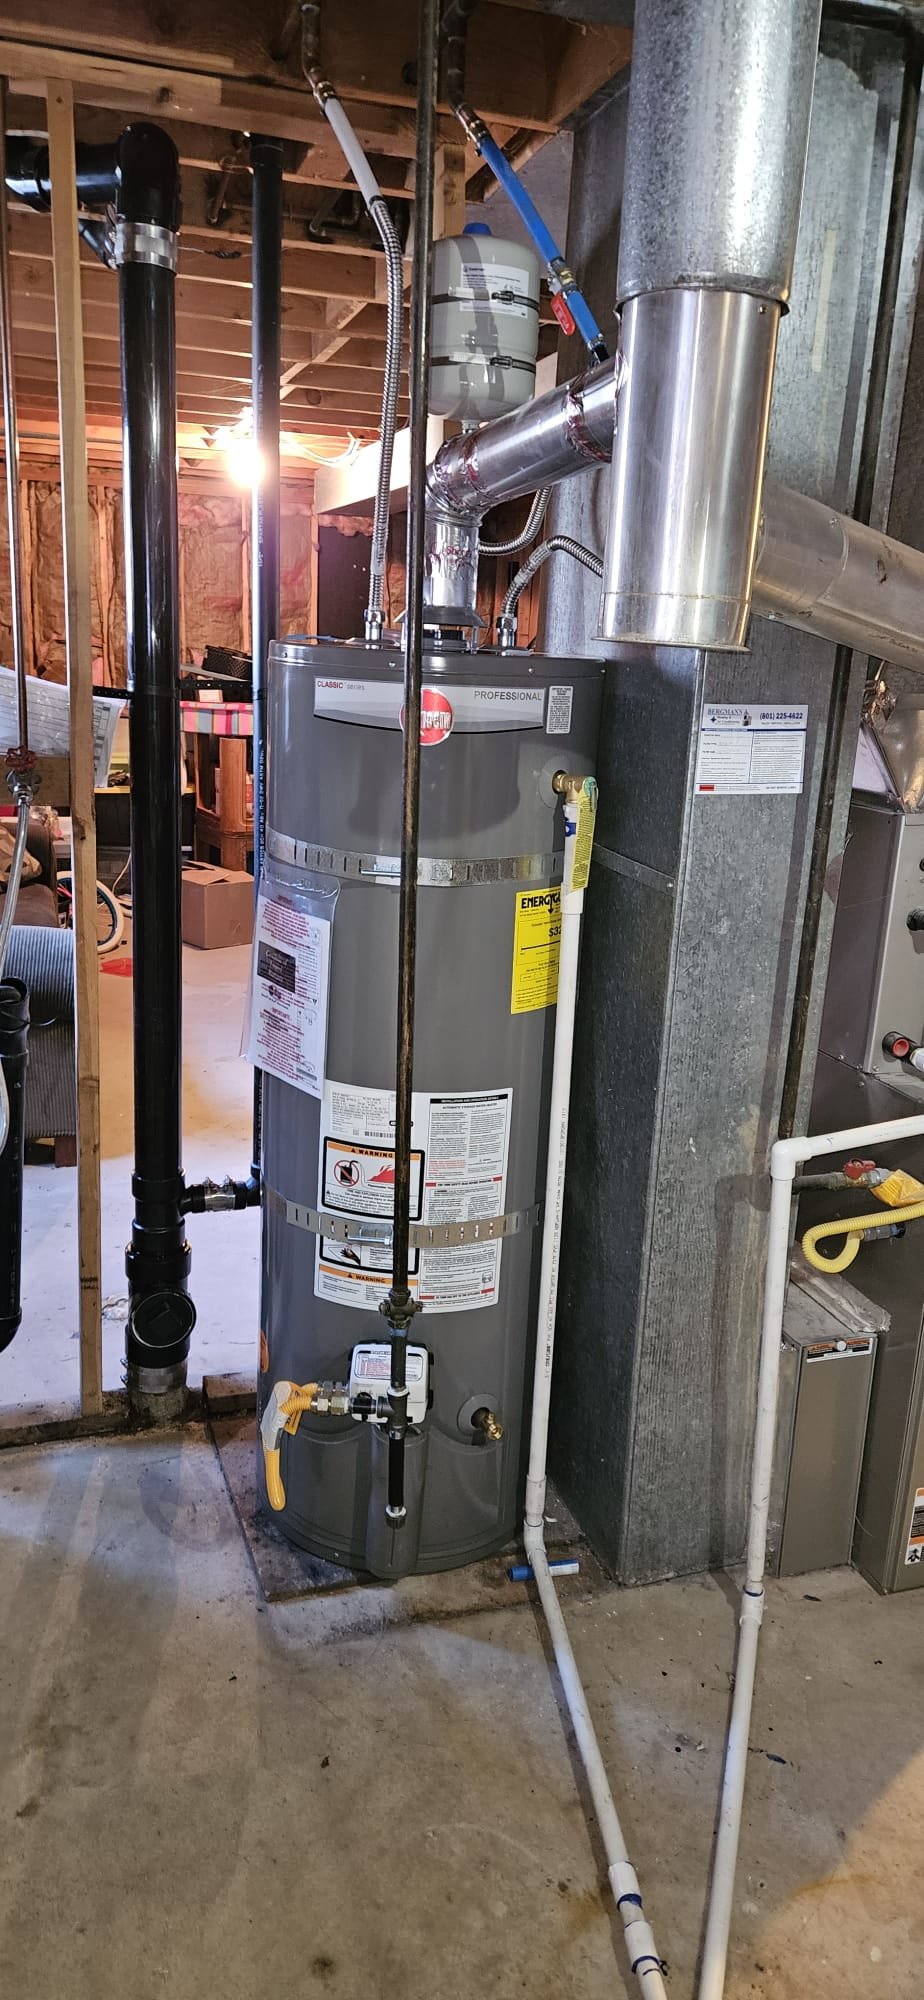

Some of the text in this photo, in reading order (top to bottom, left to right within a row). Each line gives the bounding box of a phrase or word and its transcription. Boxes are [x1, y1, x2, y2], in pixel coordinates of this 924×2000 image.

[317, 680, 365, 691] CLASSIC series
[474, 690, 542, 701] PROFESSIONAL
[359, 1149, 393, 1159] WARNING
[356, 1275, 386, 1284] WARNING
